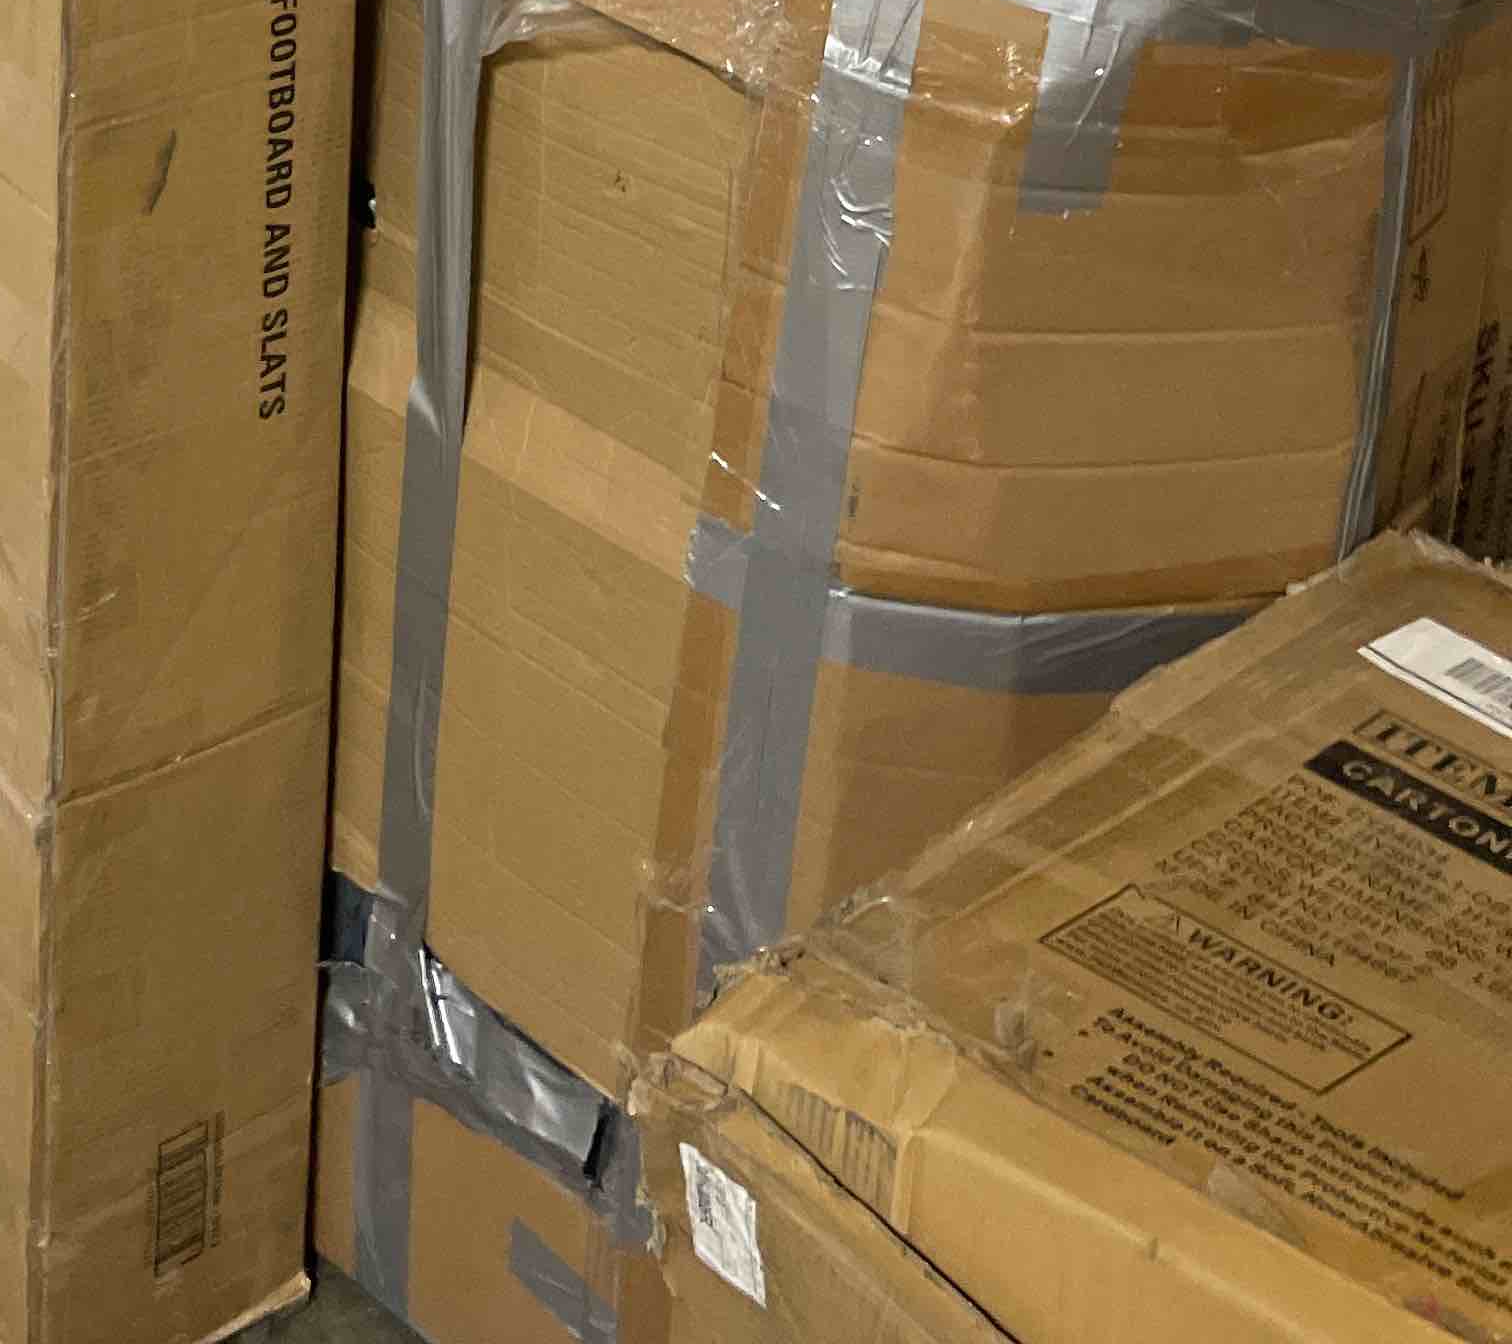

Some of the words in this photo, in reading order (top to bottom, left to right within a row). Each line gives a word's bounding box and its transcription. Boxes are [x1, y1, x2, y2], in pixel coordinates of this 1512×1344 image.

[263, 224, 290, 299] AND
[258, 309, 288, 421] SLATS
[1103, 1005, 1208, 1063] Assembly
[1200, 1056, 1302, 1113] Required
